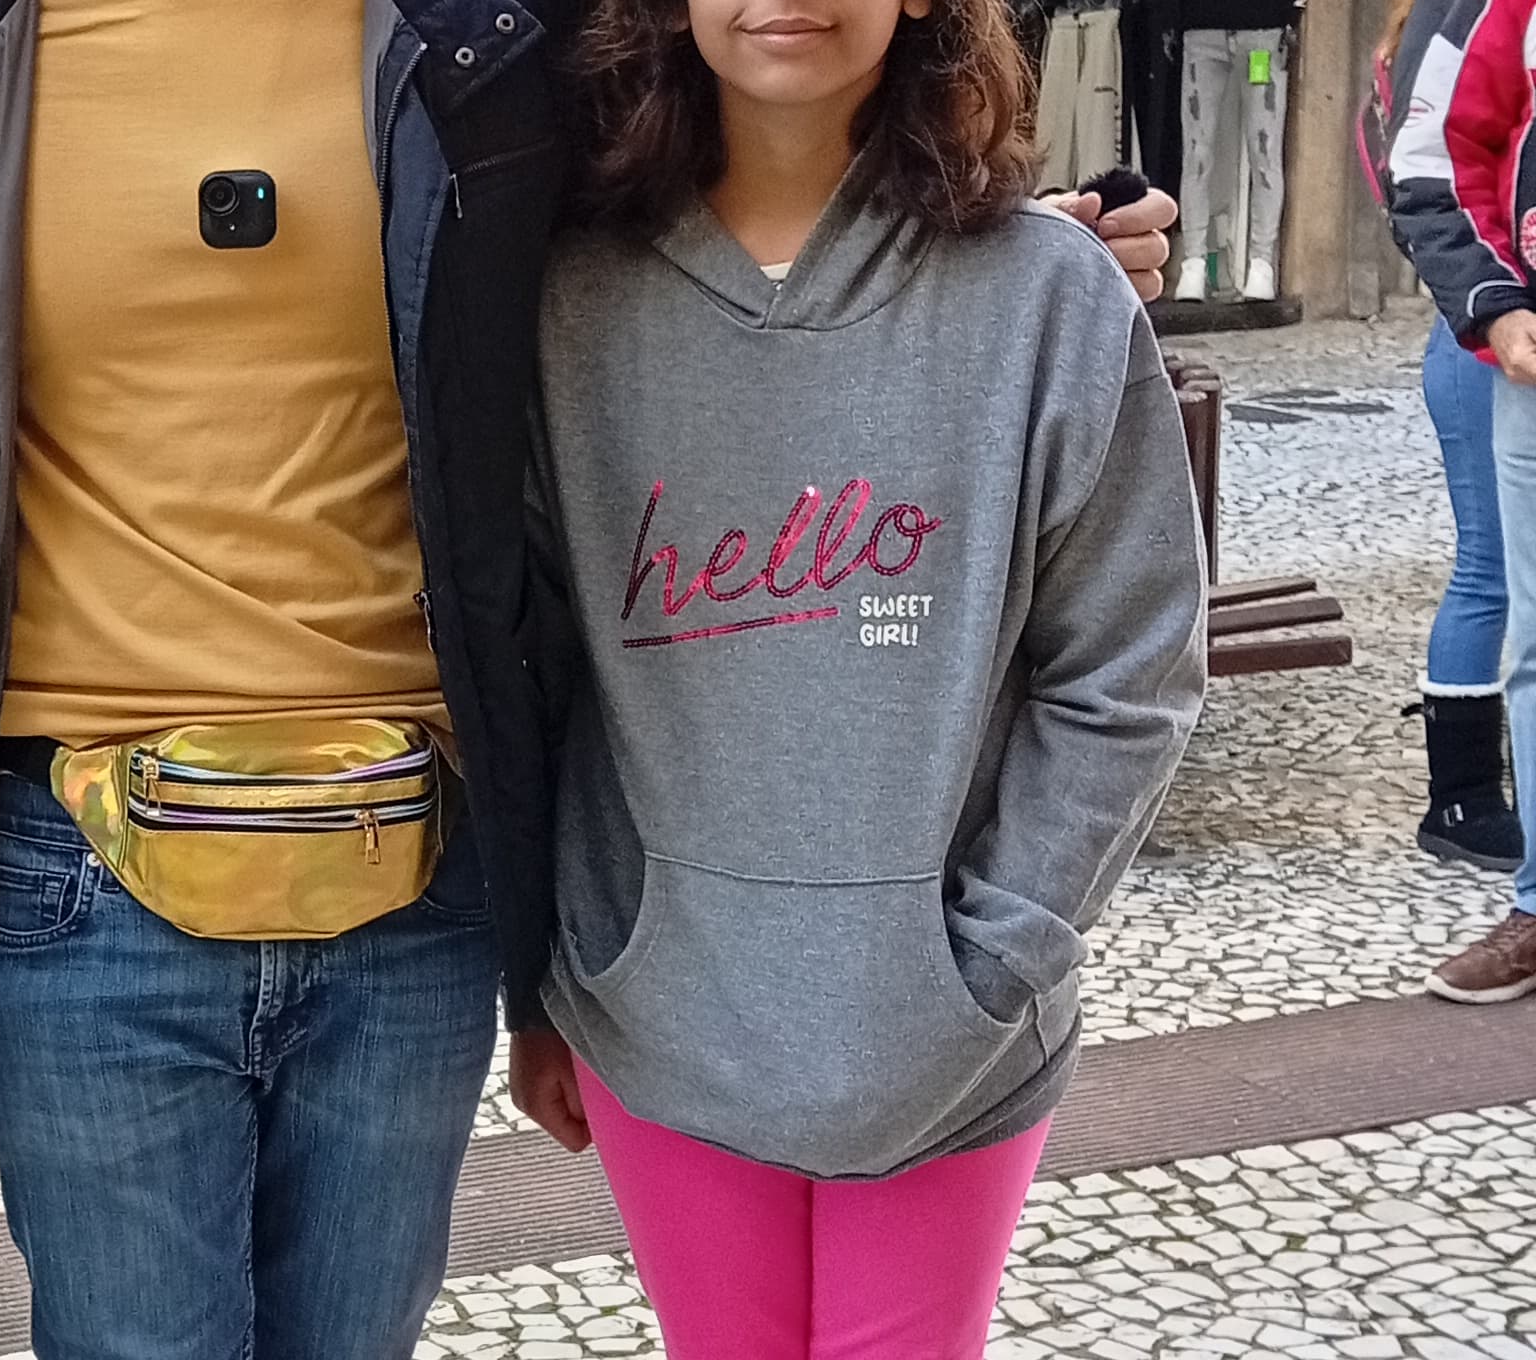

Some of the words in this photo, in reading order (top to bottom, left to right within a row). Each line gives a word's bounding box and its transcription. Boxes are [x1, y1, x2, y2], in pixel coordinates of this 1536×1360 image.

[620, 478, 943, 620] hello
[858, 593, 934, 618] SWEET
[858, 622, 919, 648] GIRL!
